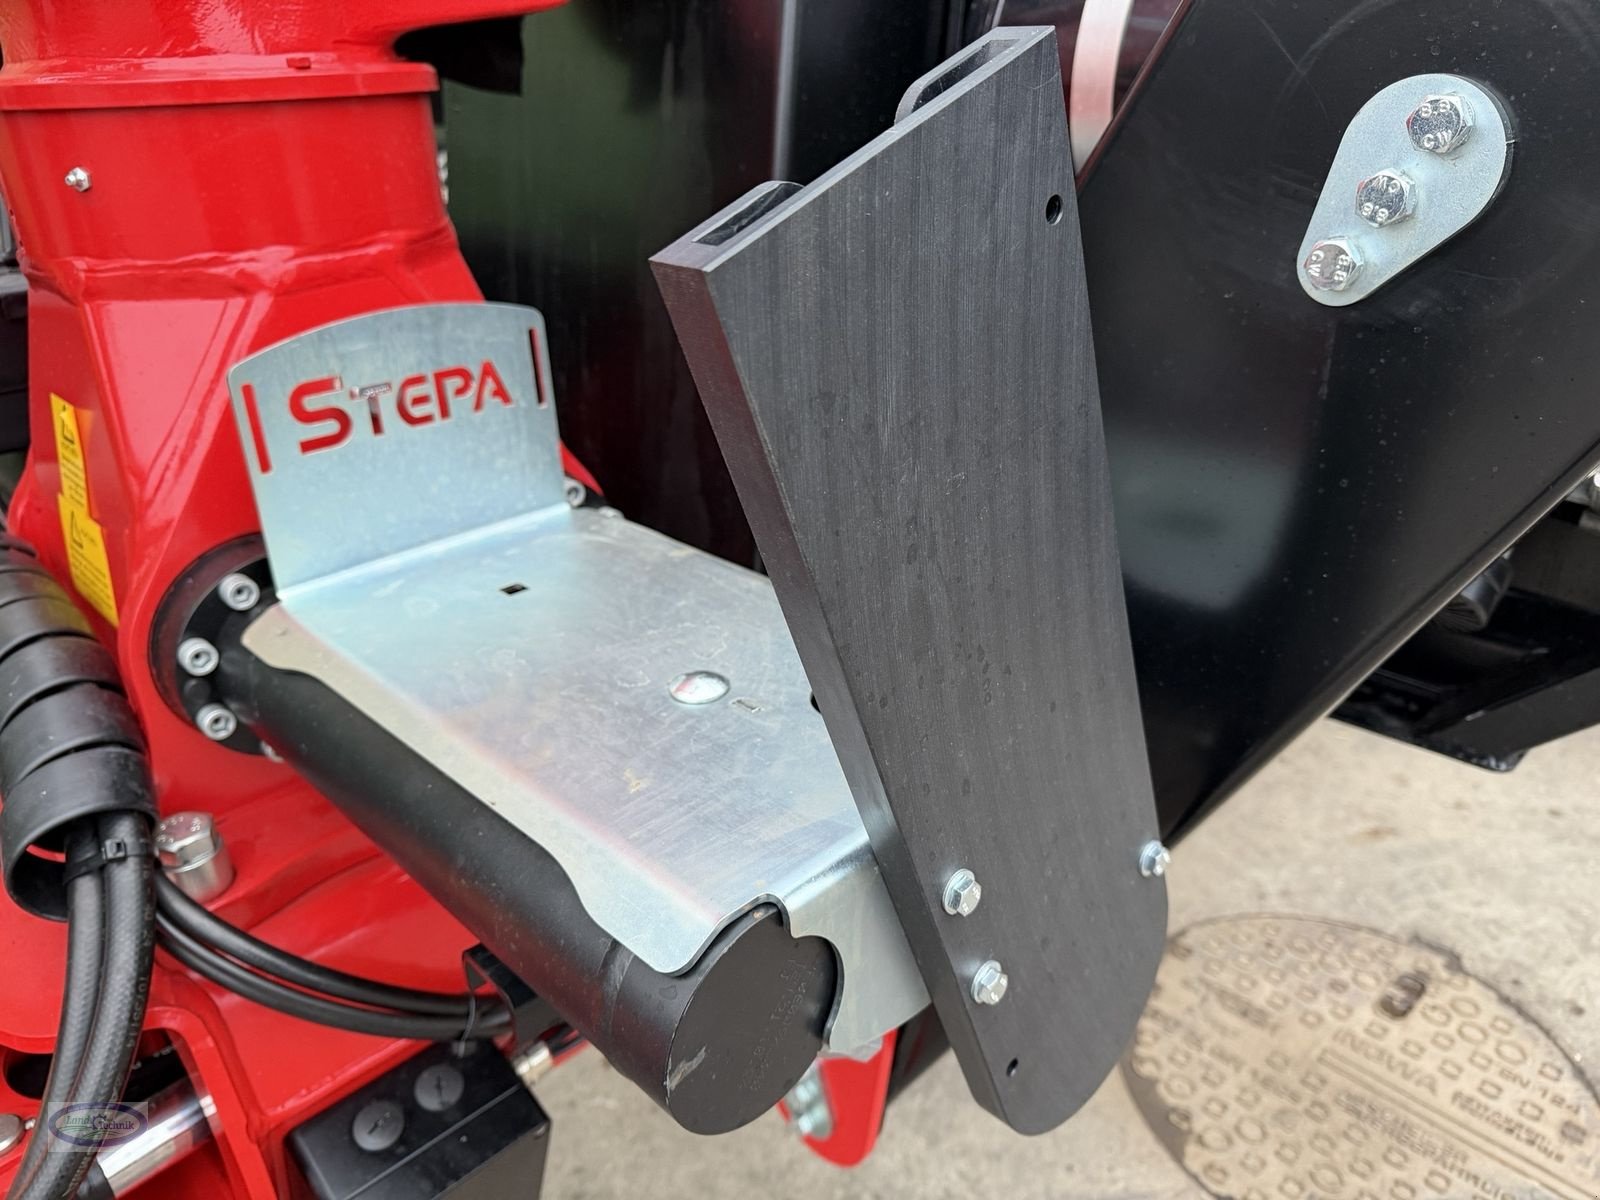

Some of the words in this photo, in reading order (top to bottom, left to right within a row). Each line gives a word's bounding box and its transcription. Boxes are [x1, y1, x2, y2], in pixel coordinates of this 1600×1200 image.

[1419, 100, 1450, 118] 8.8
[1361, 202, 1389, 222] 8.8
[1333, 254, 1350, 281] 8.8
[287, 358, 515, 455] STEPA
[1332, 1028, 1439, 1096] INOWA
